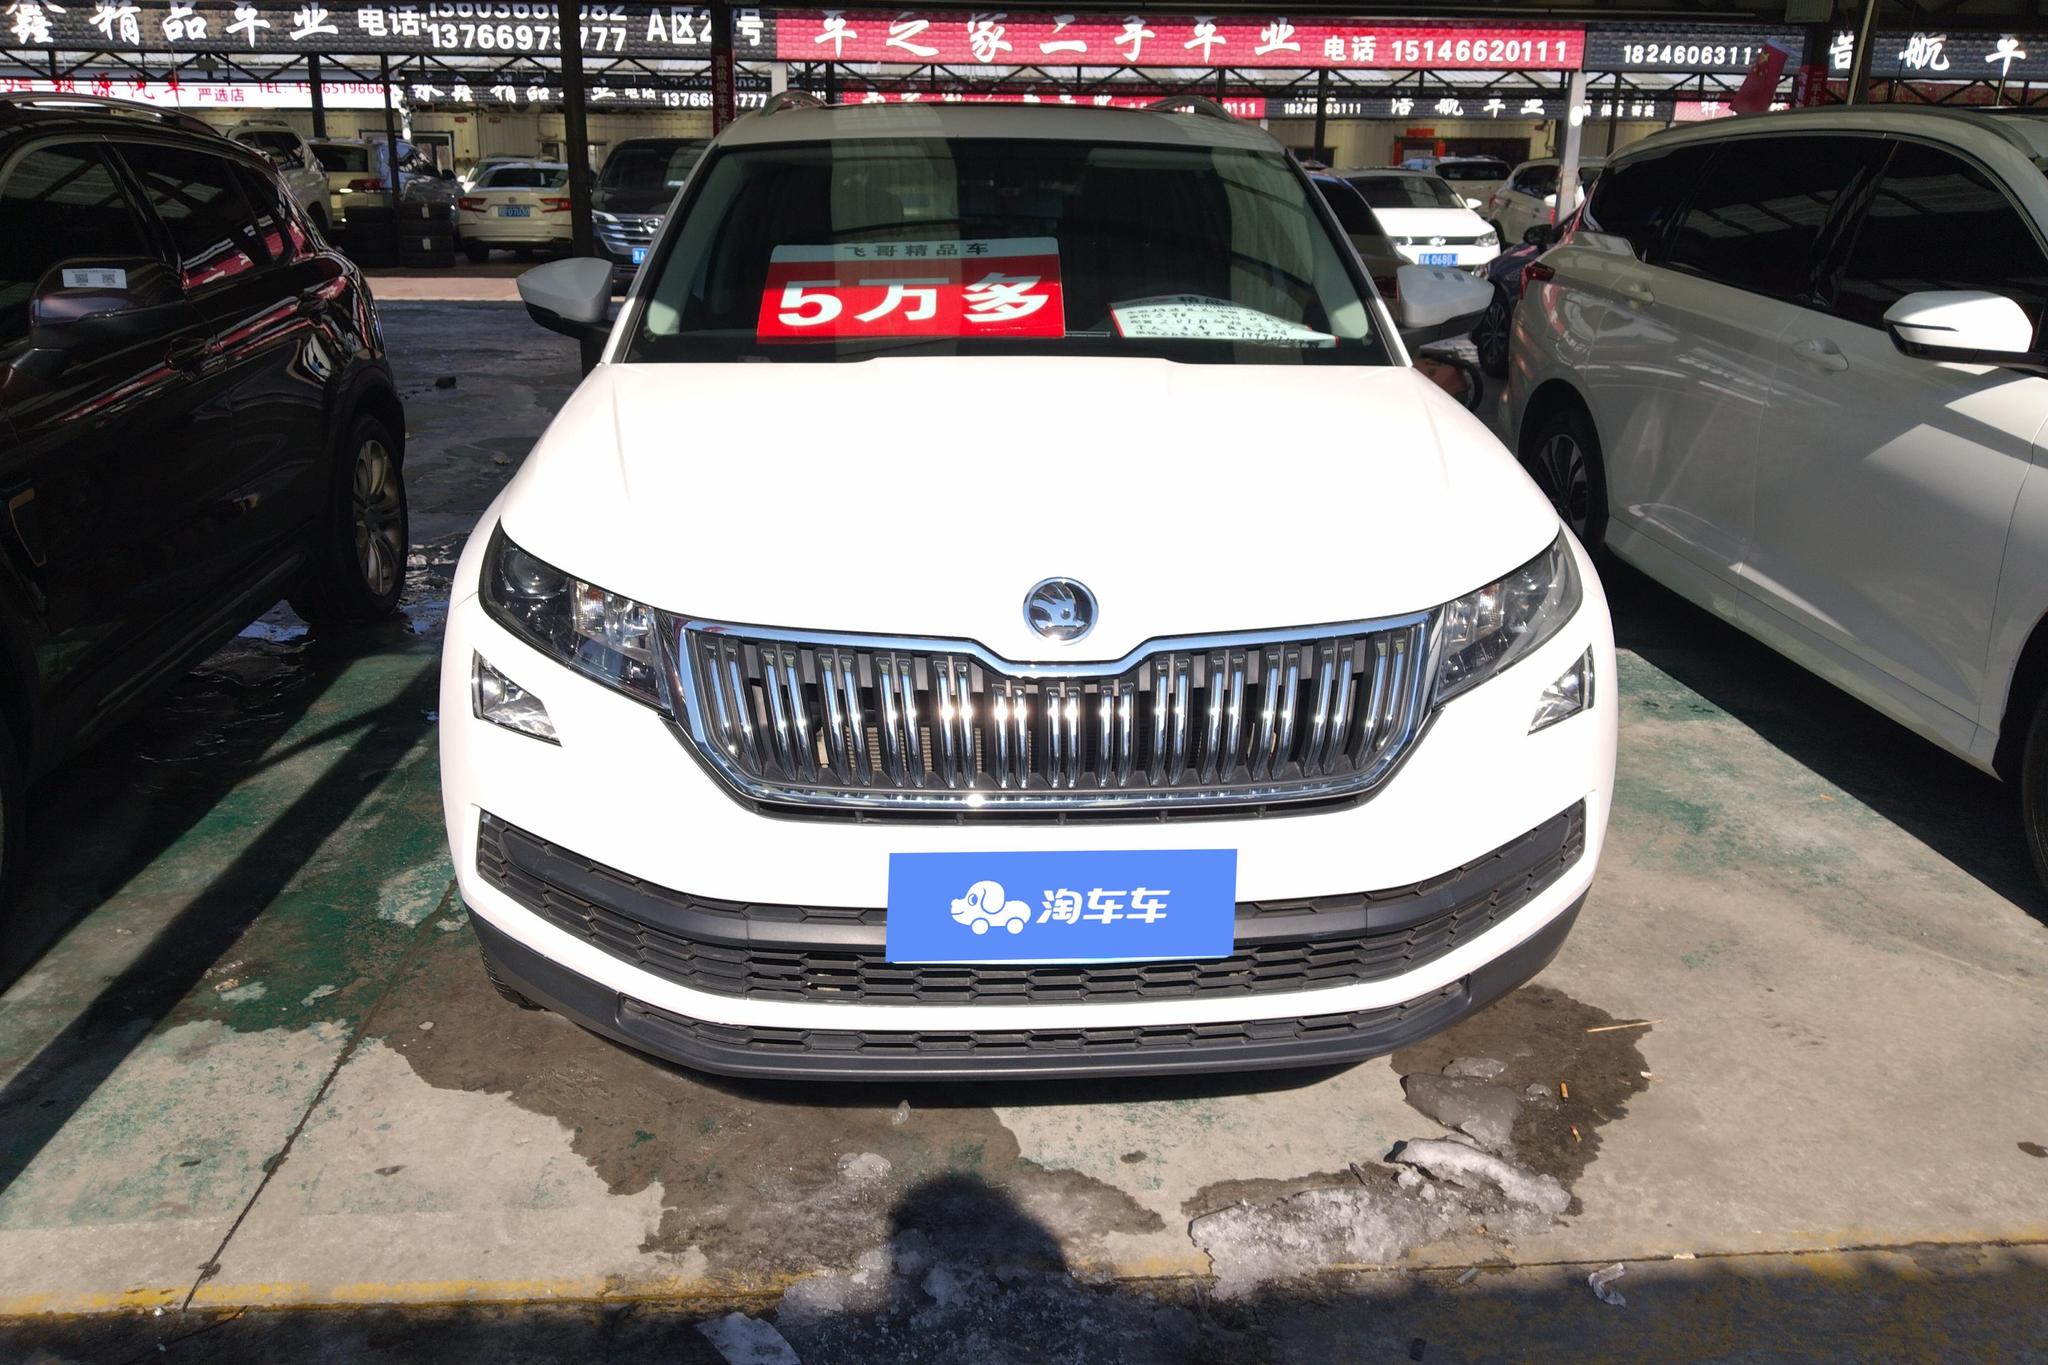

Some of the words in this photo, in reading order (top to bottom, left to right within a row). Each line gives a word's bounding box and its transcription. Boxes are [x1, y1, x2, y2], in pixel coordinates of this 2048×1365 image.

[1323, 35, 1377, 62] 电话
[1392, 40, 1567, 63] 15146620111
[1623, 44, 1762, 65] 1824606311
[198, 86, 245, 102] 严选店
[662, 92, 768, 108] 13766777
[1284, 102, 1361, 115] 1824663111
[844, 242, 989, 257] 飞哥精品车
[777, 271, 1050, 327] 5万多
